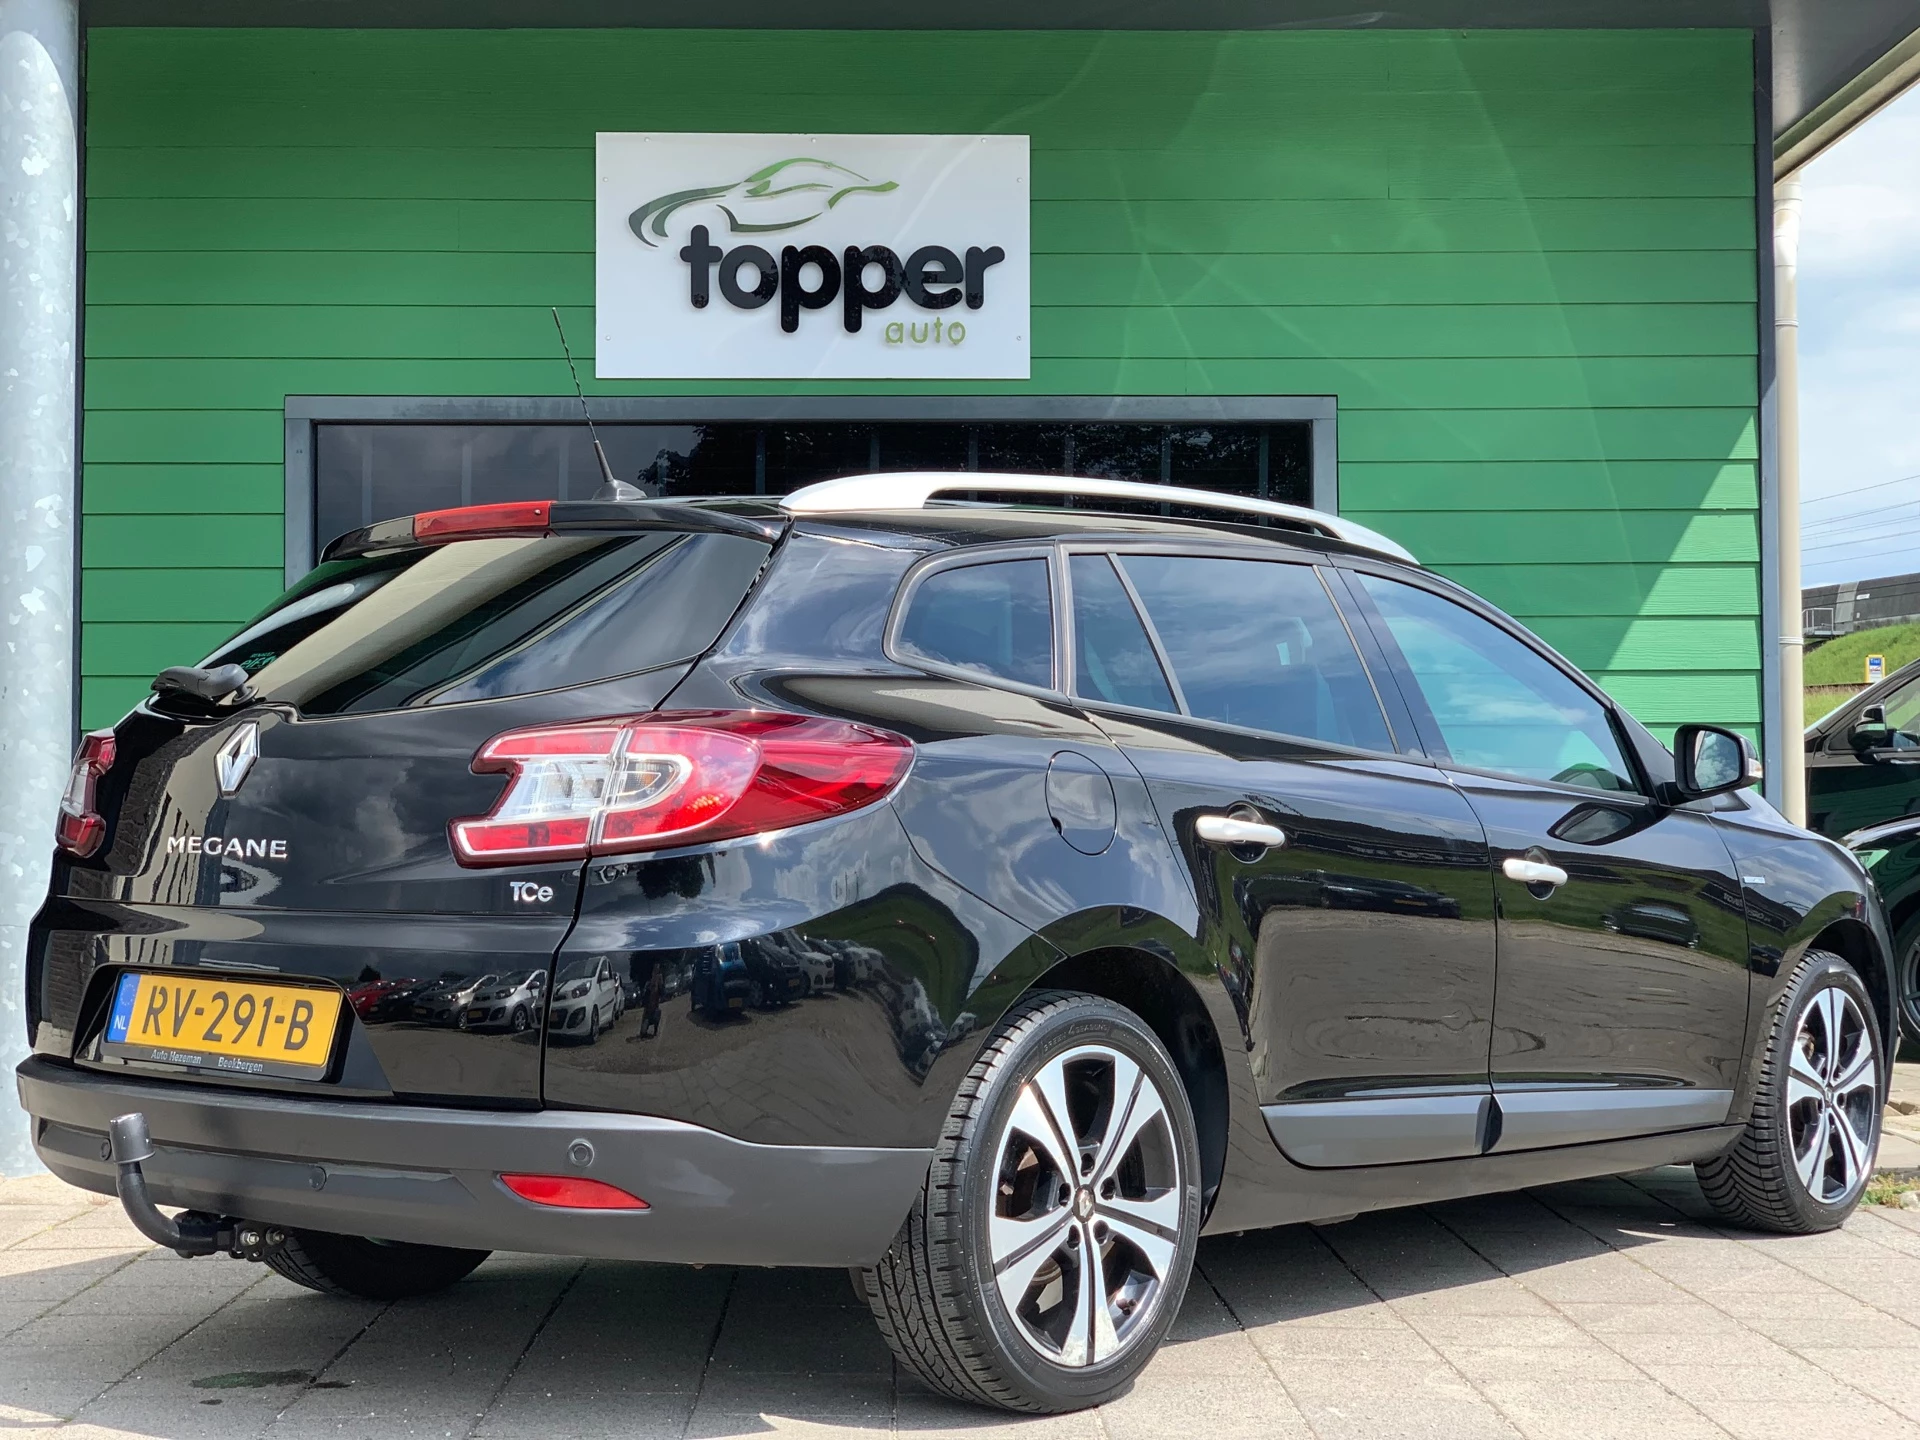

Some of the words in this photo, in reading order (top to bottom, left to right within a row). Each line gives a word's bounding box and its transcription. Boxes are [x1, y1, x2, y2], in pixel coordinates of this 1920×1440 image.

[679, 224, 1006, 334] topper
[885, 316, 967, 345] auto
[166, 835, 288, 859] MEGANE
[509, 881, 554, 903] TCe
[113, 1014, 127, 1030] NL
[141, 985, 314, 1051] RV-291-B
[151, 1049, 168, 1061] Auto
